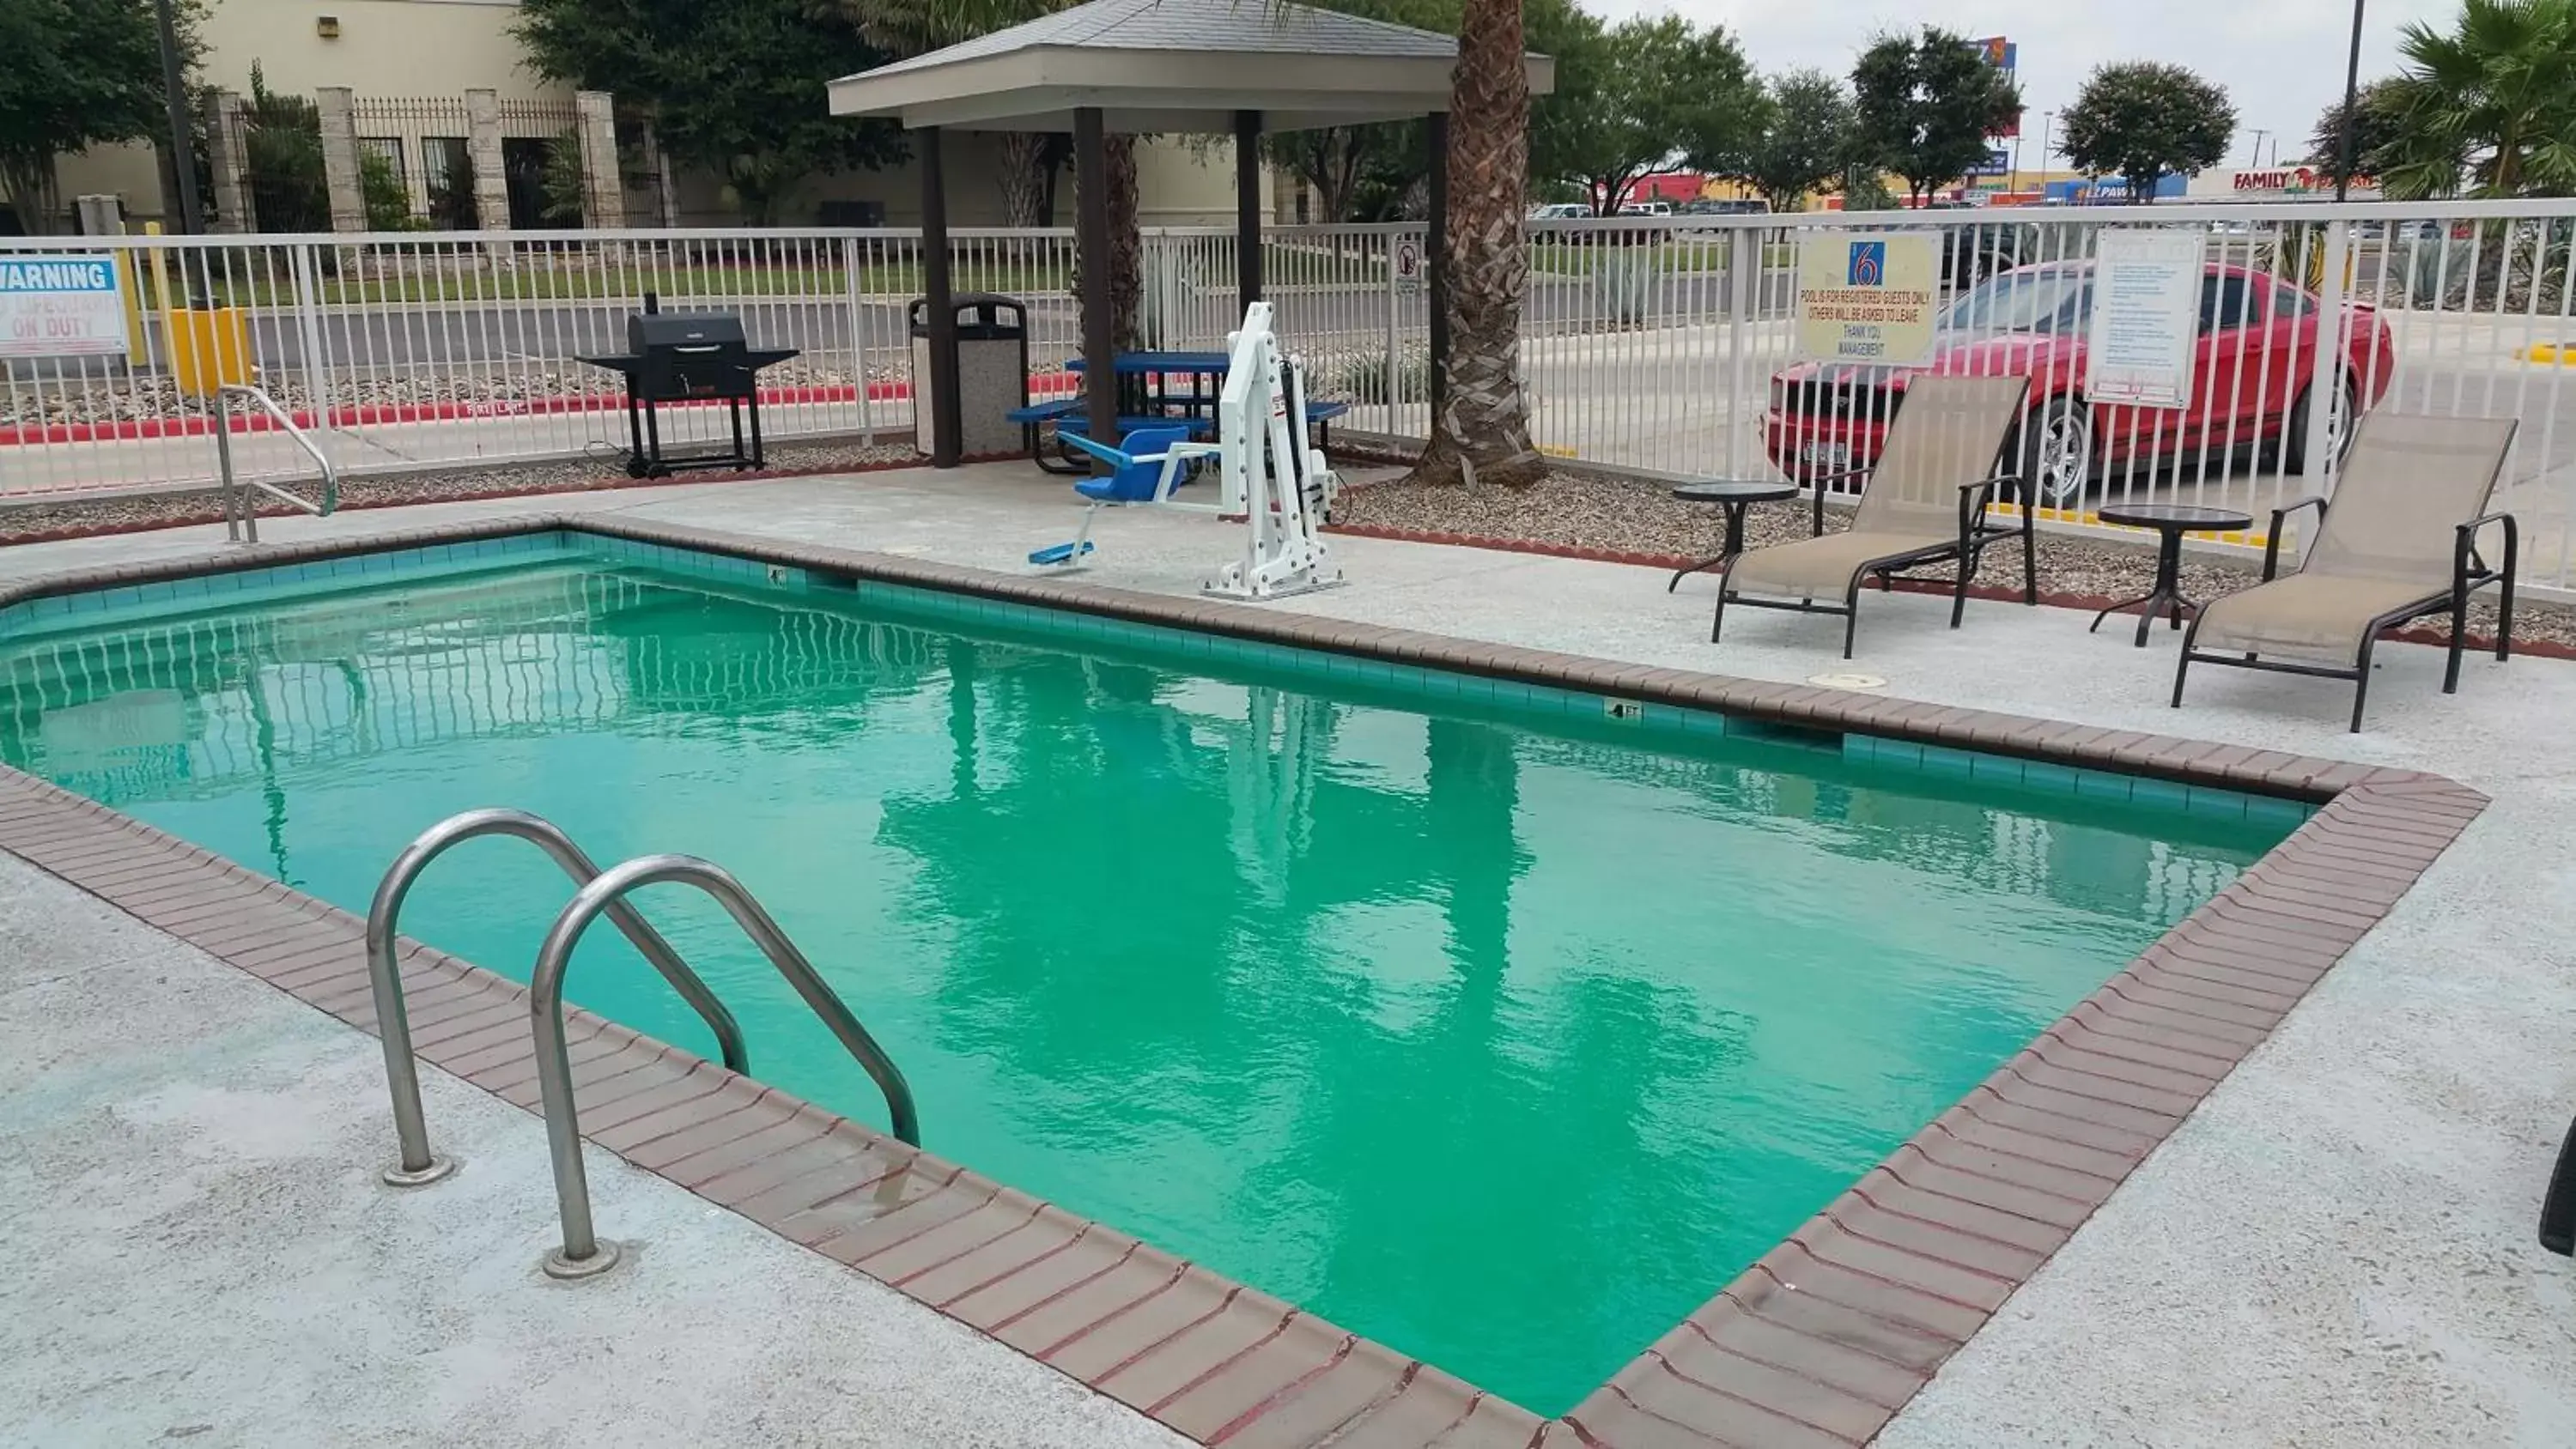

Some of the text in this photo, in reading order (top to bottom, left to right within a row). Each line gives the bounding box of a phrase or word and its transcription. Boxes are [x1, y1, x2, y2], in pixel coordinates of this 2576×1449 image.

[2234, 173, 2289, 190] FAMILY
[1855, 243, 1877, 286] 6
[0, 264, 106, 289] ARNING
[1801, 289, 1818, 302] POOL
[1826, 289, 1840, 302] FOR
[1841, 290, 1881, 304] REGISTERED
[1883, 291, 1911, 304] GUESTS
[1911, 291, 1930, 305] ONLY
[1808, 306, 1833, 319] OTHERS
[1852, 307, 1861, 321] BE
[1862, 308, 1884, 322] ASKED
[1886, 308, 1895, 322] TO
[1896, 308, 1919, 323] LEAVE
[12, 317, 92, 336] ON DUTY
[1844, 324, 1880, 339] THANK YOU
[1838, 342, 1885, 356] MANAGEMENT
